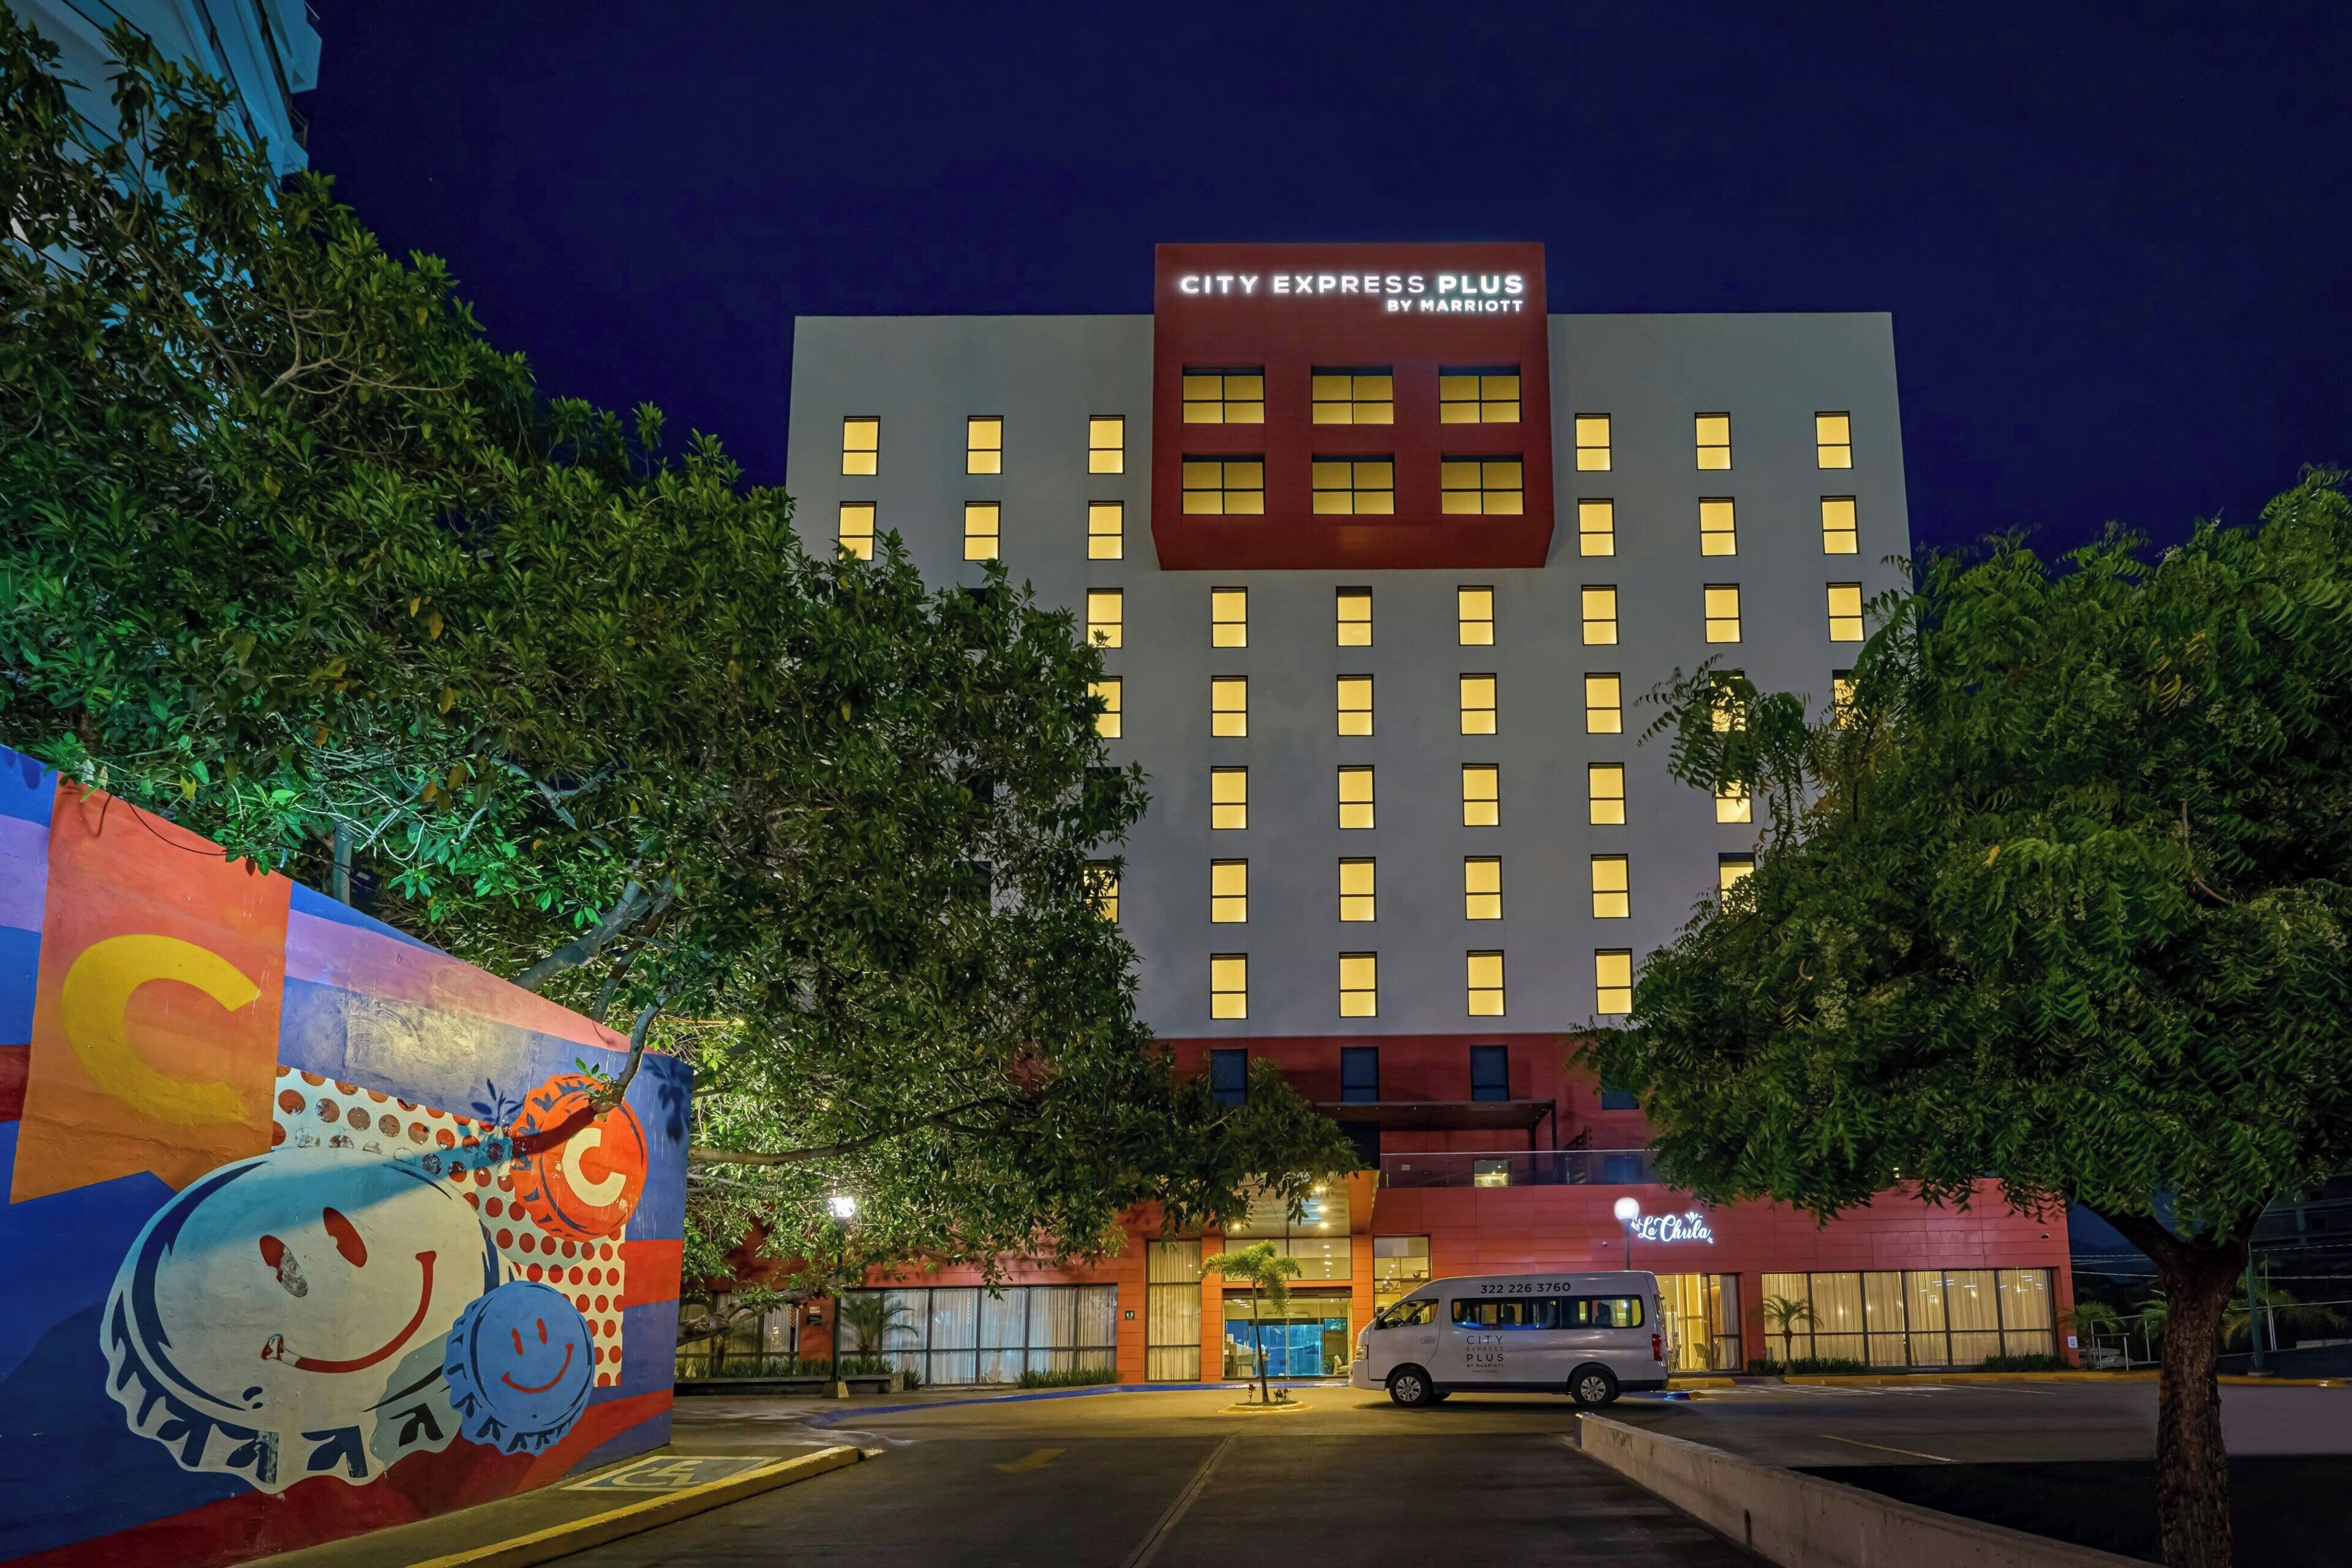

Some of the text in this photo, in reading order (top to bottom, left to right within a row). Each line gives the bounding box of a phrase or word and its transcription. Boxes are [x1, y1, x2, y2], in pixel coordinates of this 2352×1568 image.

[1180, 276, 1524, 294] CITY EXPRESS PLUS
[1387, 300, 1524, 312] BY MARRIOTT
[1637, 1215, 1711, 1242] La Chula
[1480, 1283, 1571, 1294] 322 226 3760
[1466, 1335, 1503, 1344] CITY
